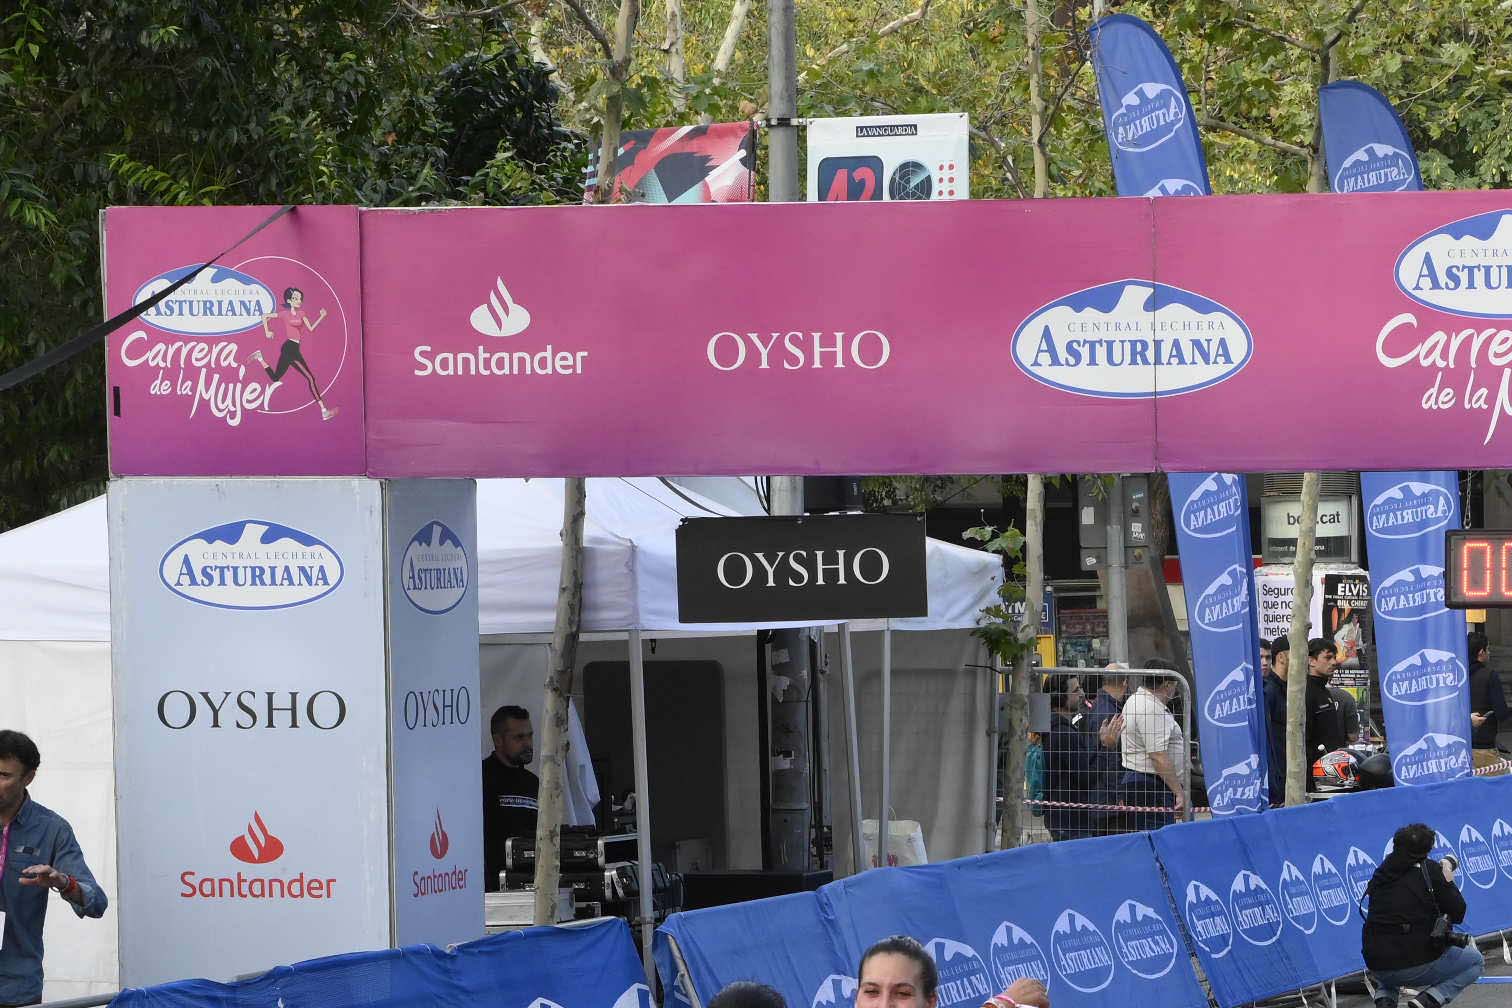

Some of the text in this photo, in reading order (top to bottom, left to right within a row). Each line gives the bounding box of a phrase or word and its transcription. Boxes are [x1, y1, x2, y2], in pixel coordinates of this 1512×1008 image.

[171, 288, 211, 297] ENTRAL
[1067, 320, 1225, 333] CENTRAL LECHERA
[120, 331, 239, 368] Carrera
[413, 343, 588, 377] Santander
[706, 330, 891, 371] OYSHO
[1030, 325, 1234, 367] ASTURIANA
[150, 366, 283, 426] de la Mujer
[1422, 371, 1456, 410] de
[1464, 371, 1488, 410] la
[174, 553, 330, 588] ASTURIANA
[202, 550, 325, 561] CENTRAL LECHERA
[716, 547, 890, 589] OYSHO
[406, 557, 465, 591] ASTURIANA
[1337, 583, 1368, 596] ELVIS
[1263, 600, 1279, 612] que
[1263, 613, 1295, 625] quiere
[157, 690, 347, 730] OYSHO
[404, 685, 471, 730] OYSHO
[180, 871, 337, 898] Santander
[413, 865, 468, 898] Santander
[1056, 944, 1111, 975] ASTURIANA
